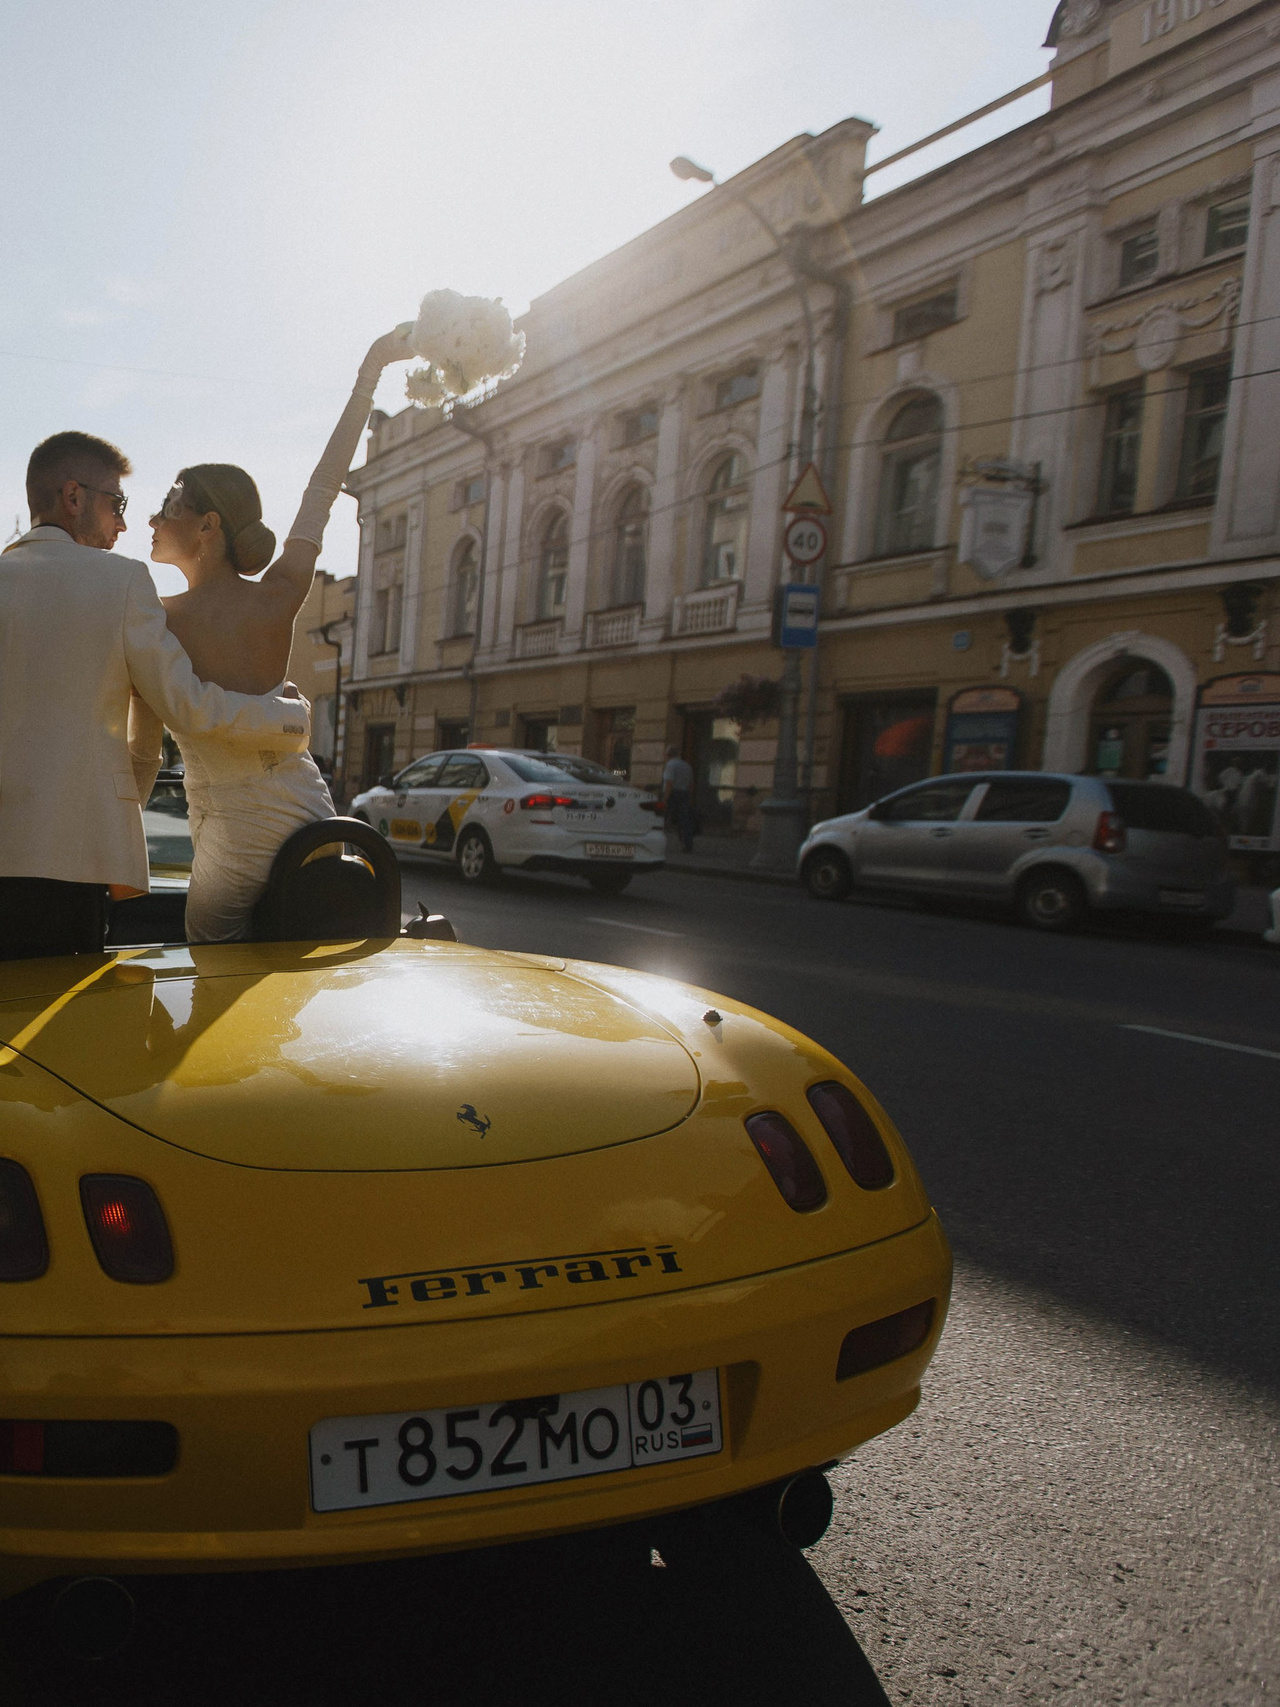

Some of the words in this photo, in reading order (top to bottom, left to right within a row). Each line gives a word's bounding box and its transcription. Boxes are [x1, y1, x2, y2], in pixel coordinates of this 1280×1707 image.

[1141, 0, 1225, 46] 190
[794, 532, 818, 549] 40
[358, 1245, 682, 1309] Ferrari
[637, 1374, 695, 1431] 03
[636, 1431, 679, 1454] RUS
